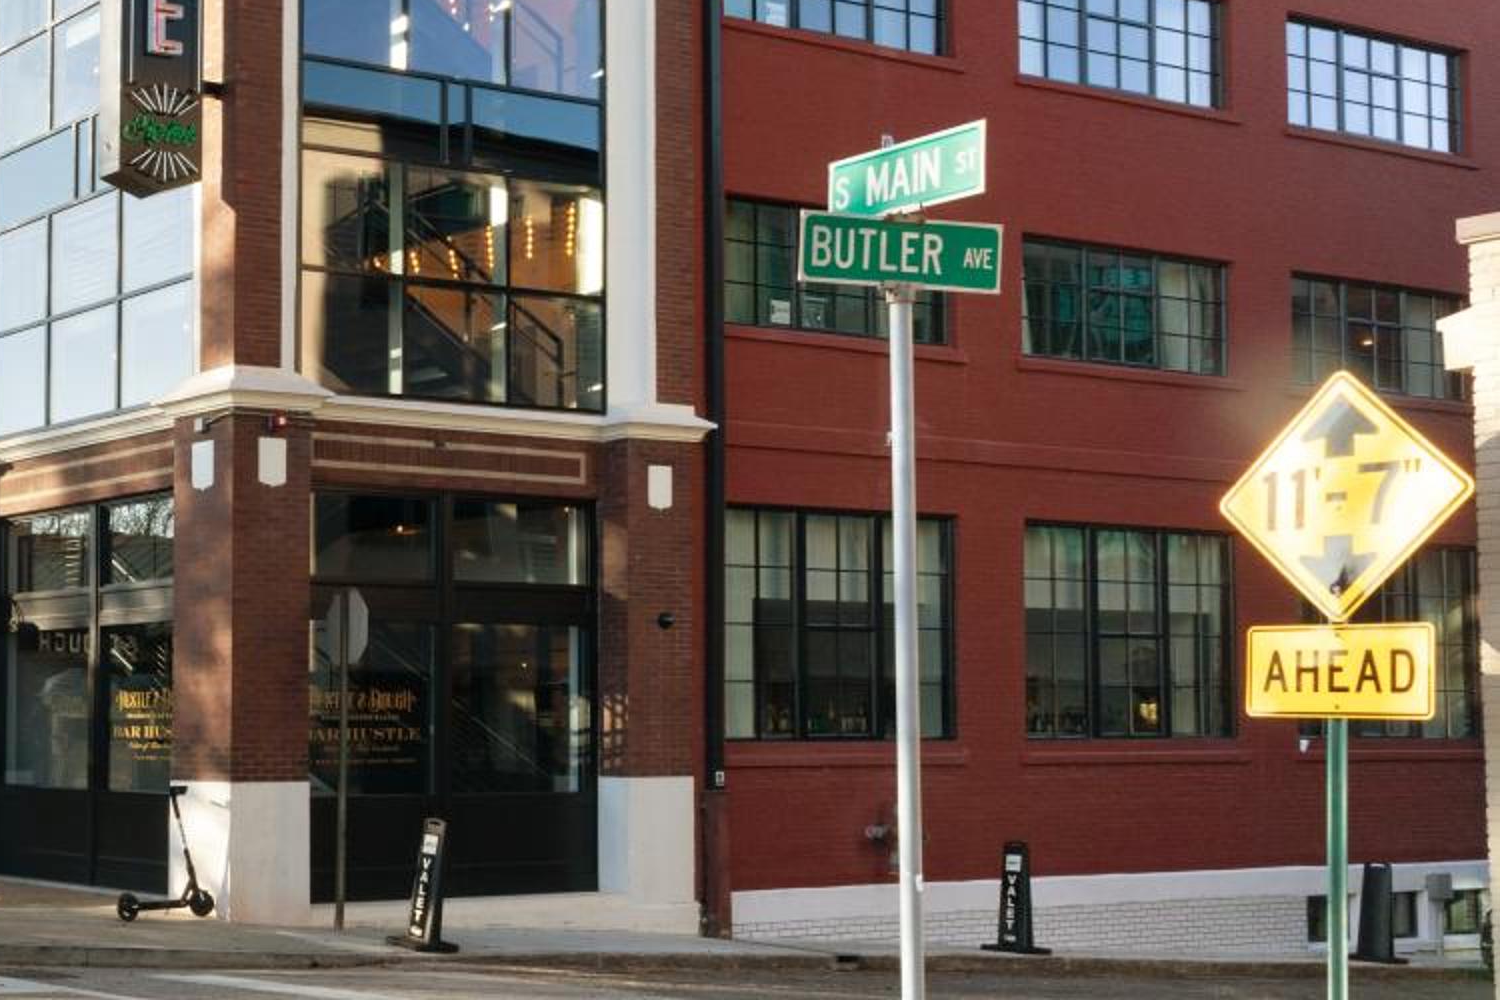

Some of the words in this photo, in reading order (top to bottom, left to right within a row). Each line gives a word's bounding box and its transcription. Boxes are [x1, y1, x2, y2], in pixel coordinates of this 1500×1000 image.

[835, 177, 850, 209] S
[866, 147, 941, 207] MAIN
[955, 147, 975, 175] ST
[811, 225, 944, 276] BUTLER
[963, 248, 993, 270] AVE
[1263, 649, 1416, 694] AHEAD
[414, 857, 432, 922] VALET
[1005, 873, 1017, 930] VALET
